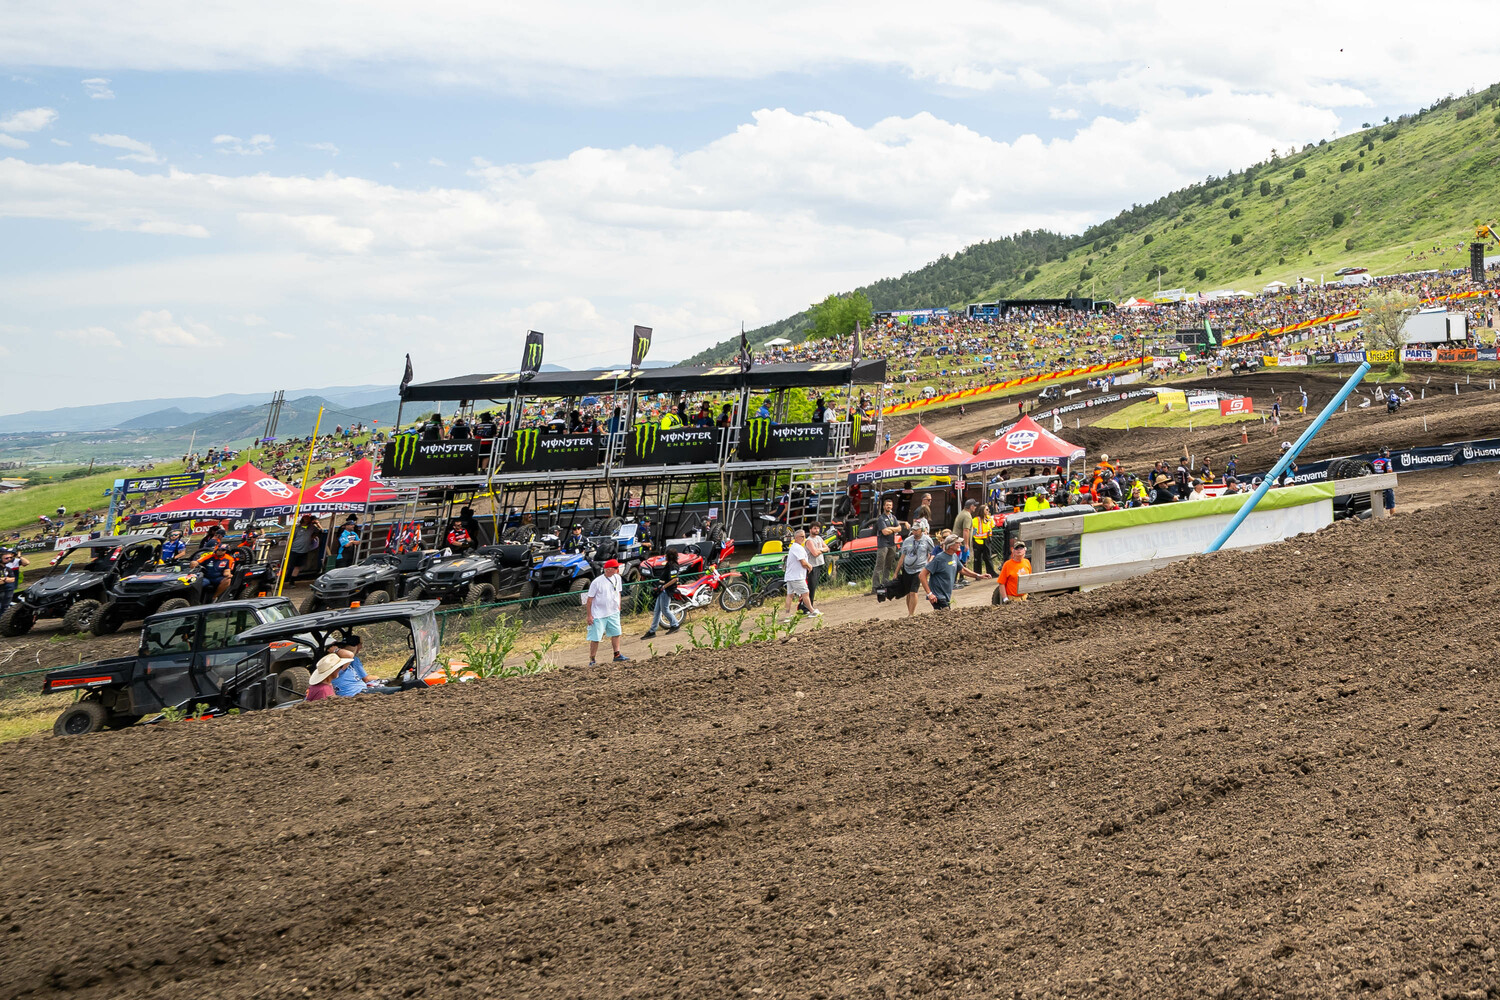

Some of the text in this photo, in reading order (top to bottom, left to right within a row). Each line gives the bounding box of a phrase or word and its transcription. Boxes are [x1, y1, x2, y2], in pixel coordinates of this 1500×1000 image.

[1405, 350, 1432, 358] PARTS
[660, 431, 711, 442] MONSTER
[772, 427, 823, 438] MONSTER
[541, 437, 593, 448] MONSTER
[420, 443, 473, 454] MONSTER
[1411, 453, 1454, 465] Husqvarna
[1294, 470, 1328, 483] usqvarna
